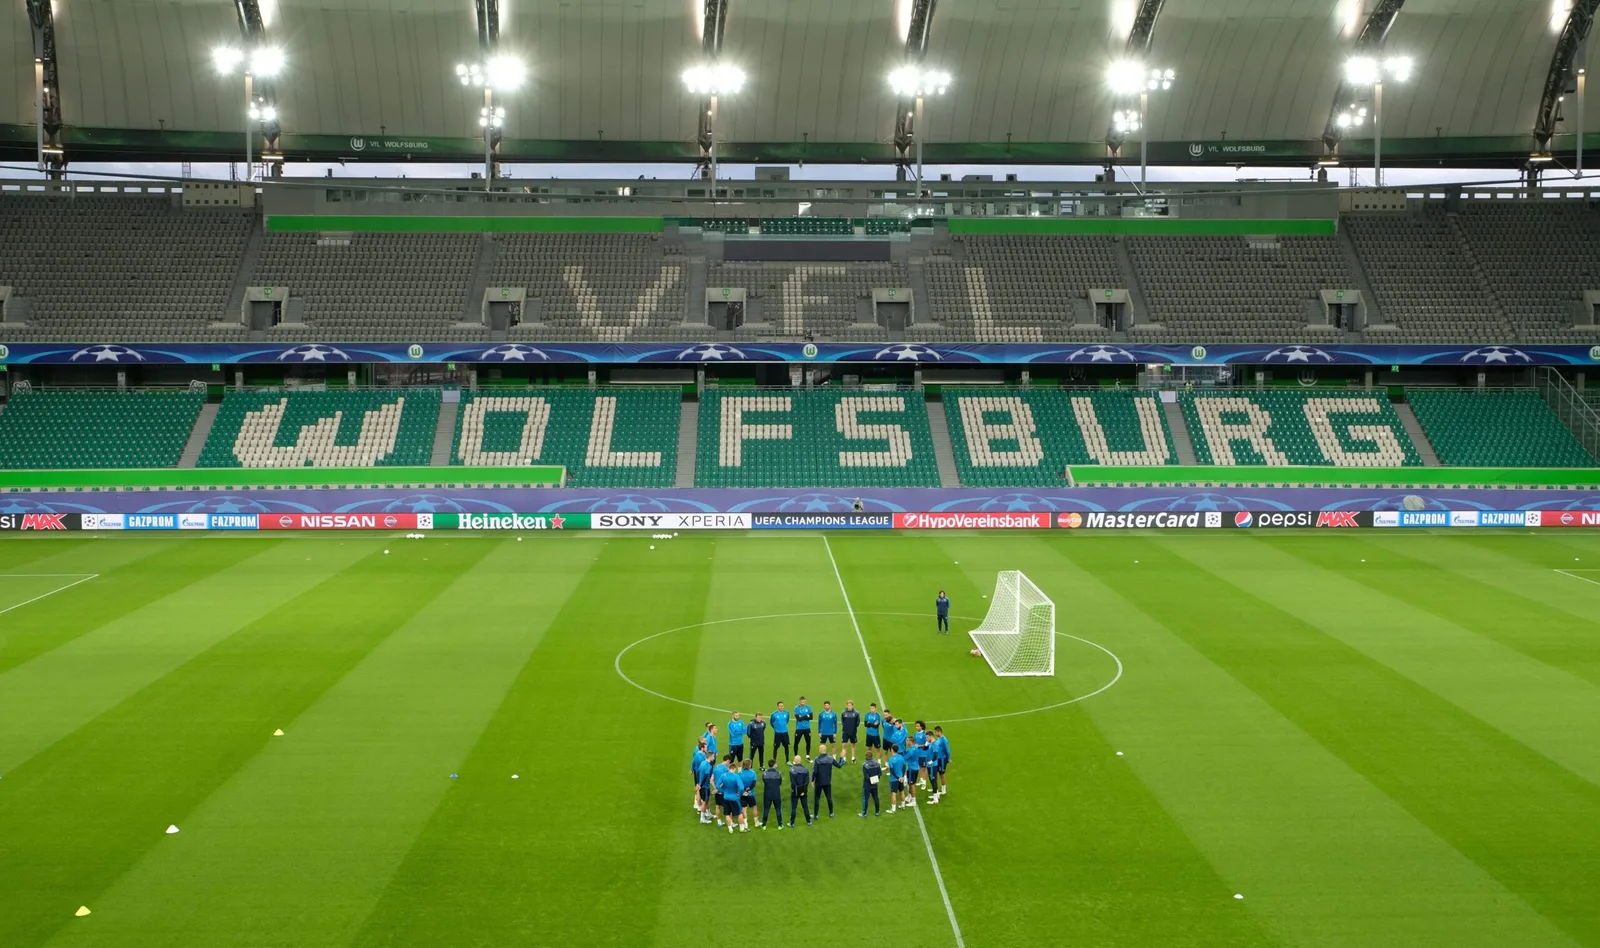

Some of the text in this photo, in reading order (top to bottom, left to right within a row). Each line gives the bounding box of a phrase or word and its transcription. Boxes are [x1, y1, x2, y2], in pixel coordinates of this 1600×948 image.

[20, 513, 67, 530] MAX
[129, 515, 174, 527] GAZPROM
[211, 516, 256, 527] GAZPROM
[301, 515, 376, 528] NISSAN
[457, 513, 548, 529] Heineken
[600, 515, 745, 527] SONY XPERIA
[755, 516, 889, 526] UEFA CHAMPIONS LEAGUE
[919, 513, 1040, 529] HypoVereinsbank
[1086, 512, 1199, 528] MasterCard
[1258, 511, 1361, 528] pepsi MAX
[1403, 513, 1446, 525] GAZPROM
[1481, 513, 1524, 525] GAZPROM
